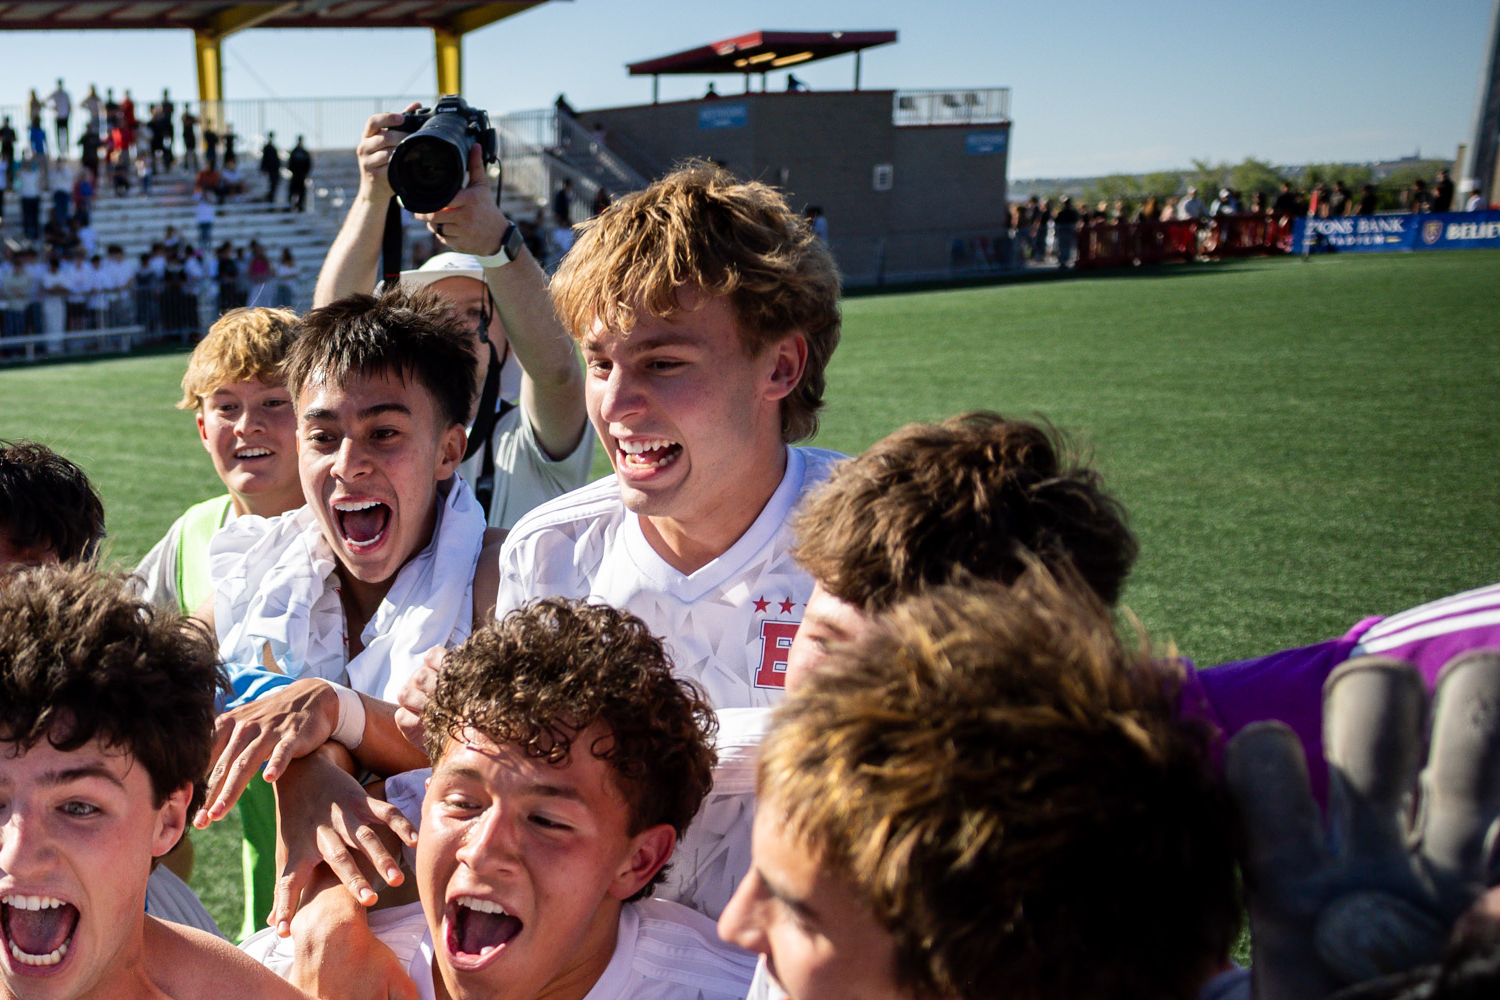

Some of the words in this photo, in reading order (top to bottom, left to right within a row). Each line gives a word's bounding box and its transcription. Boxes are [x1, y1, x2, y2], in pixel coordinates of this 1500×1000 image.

[1356, 217, 1406, 234] BANK
[1445, 221, 1500, 240] BELIE
[1322, 234, 1386, 246] TADIUM
[754, 619, 801, 690] E
